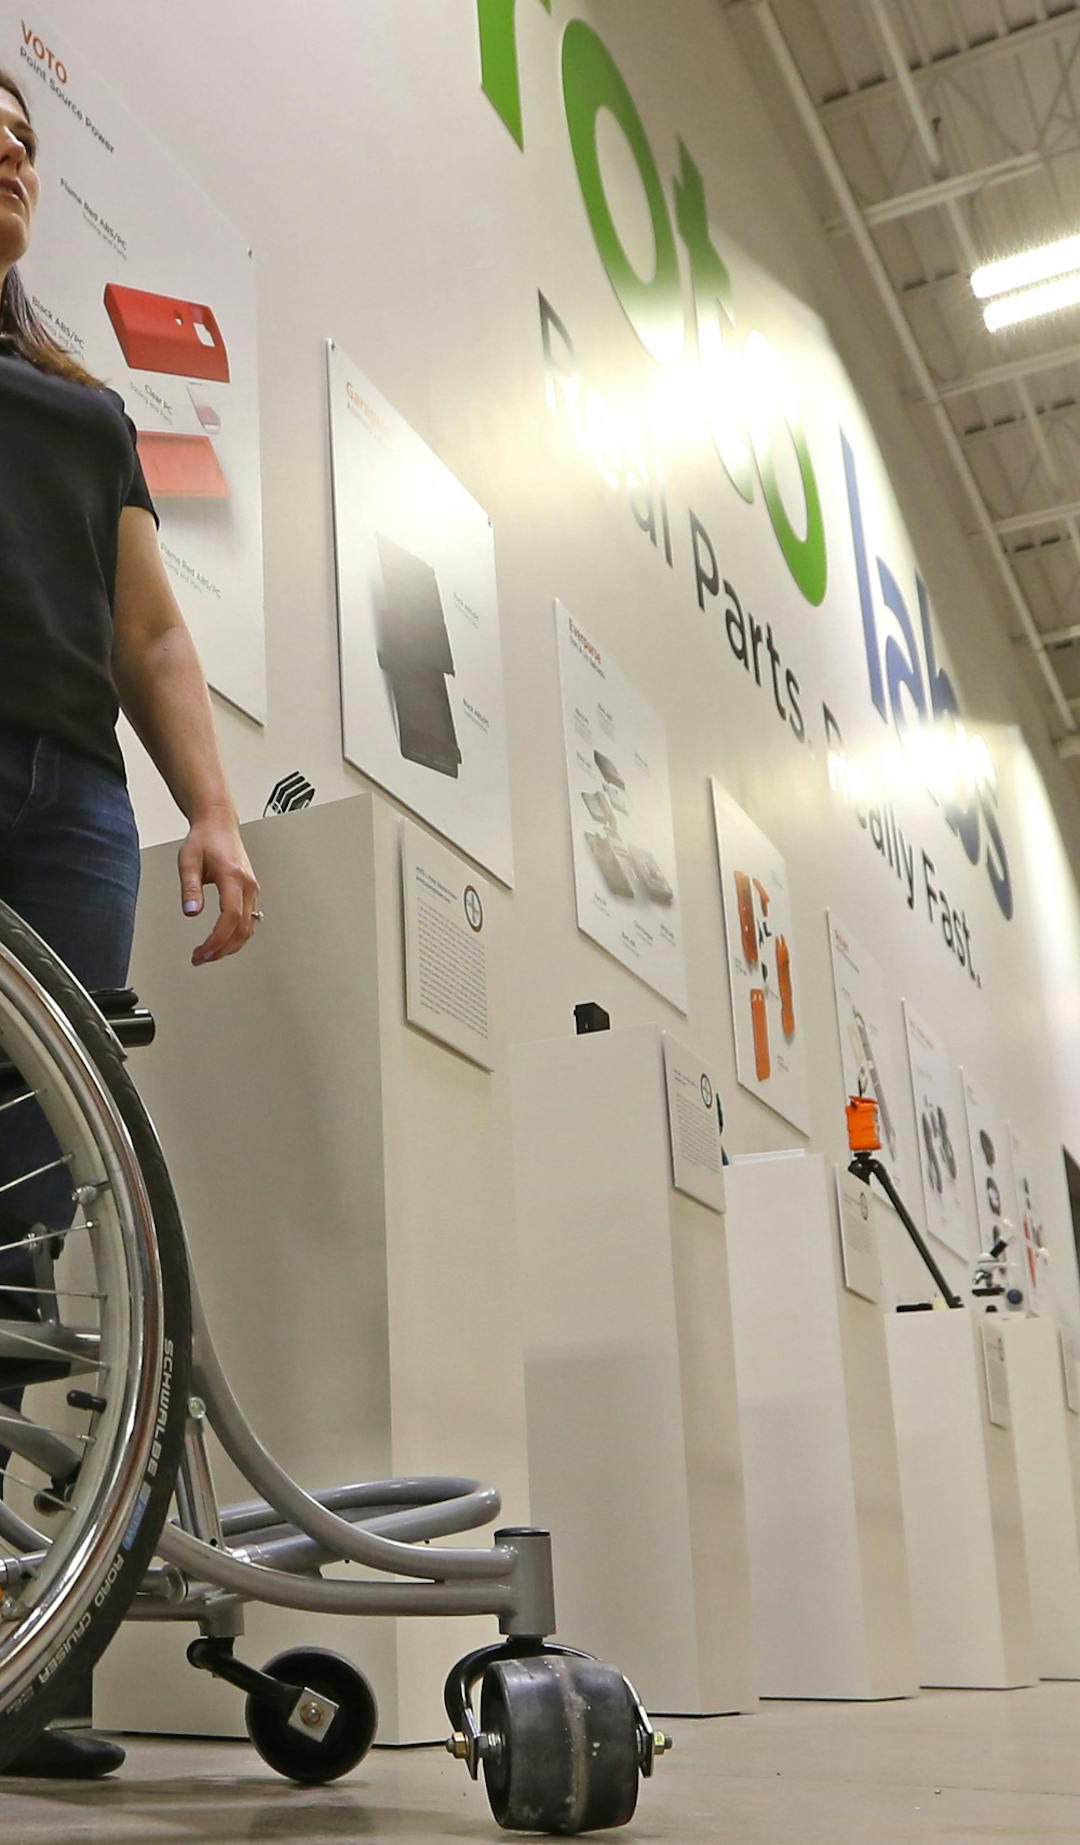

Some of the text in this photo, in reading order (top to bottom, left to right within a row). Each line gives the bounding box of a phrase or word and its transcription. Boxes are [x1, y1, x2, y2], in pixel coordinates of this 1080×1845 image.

[19, 46, 115, 154] Point Source Power
[21, 20, 68, 85] VOTO
[822, 699, 914, 911] Rally
[921, 848, 981, 990] Fast.
[148, 1338, 175, 1478] SCHWALBE
[38, 1555, 126, 1686] ROAD CRUISER
